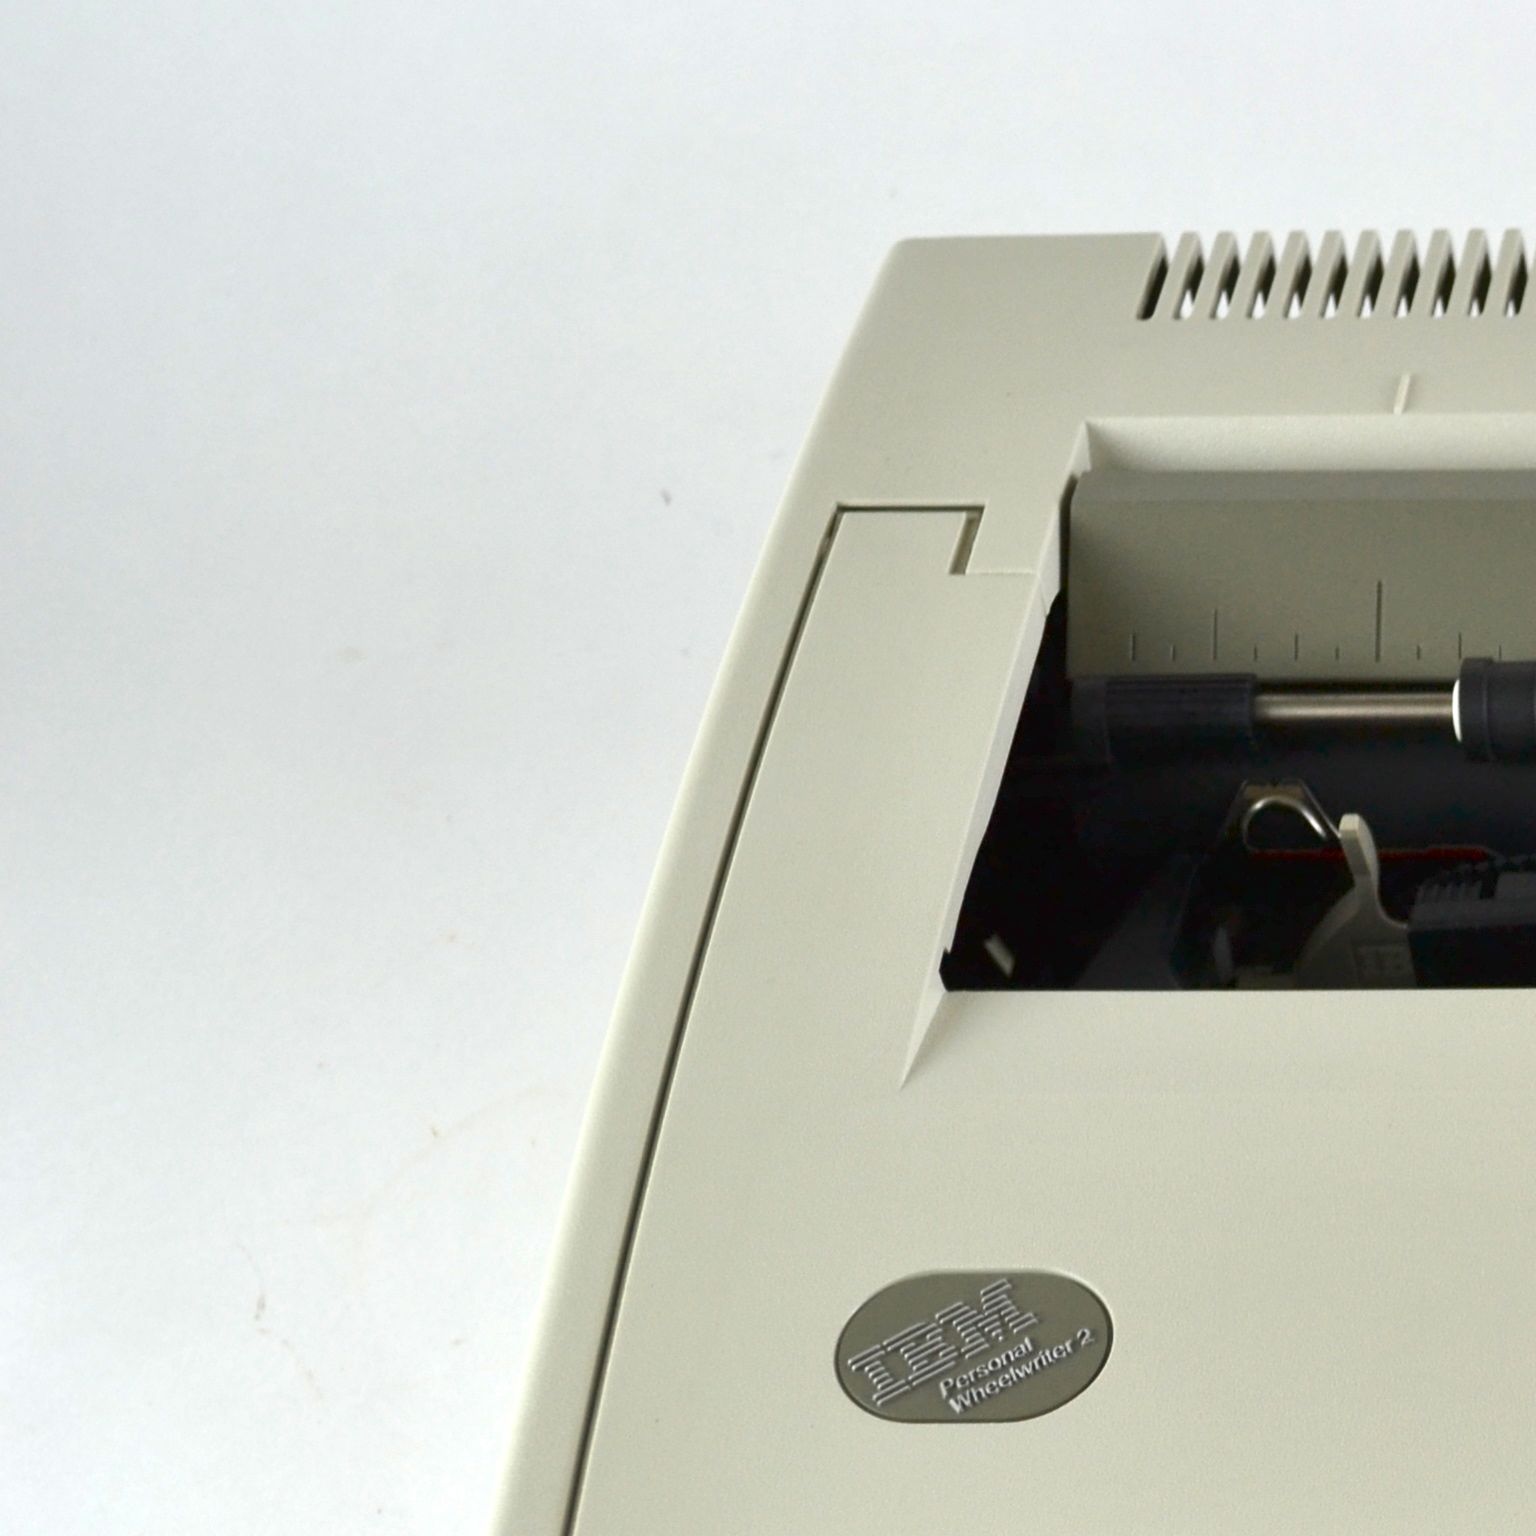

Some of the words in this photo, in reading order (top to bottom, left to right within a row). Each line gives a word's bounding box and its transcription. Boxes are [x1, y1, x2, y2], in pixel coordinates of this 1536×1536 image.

[848, 1278, 1039, 1407] IBM
[939, 1336, 1034, 1397] Personal
[949, 1340, 1073, 1414] Wheelwriter
[1076, 1327, 1095, 1347] 2
